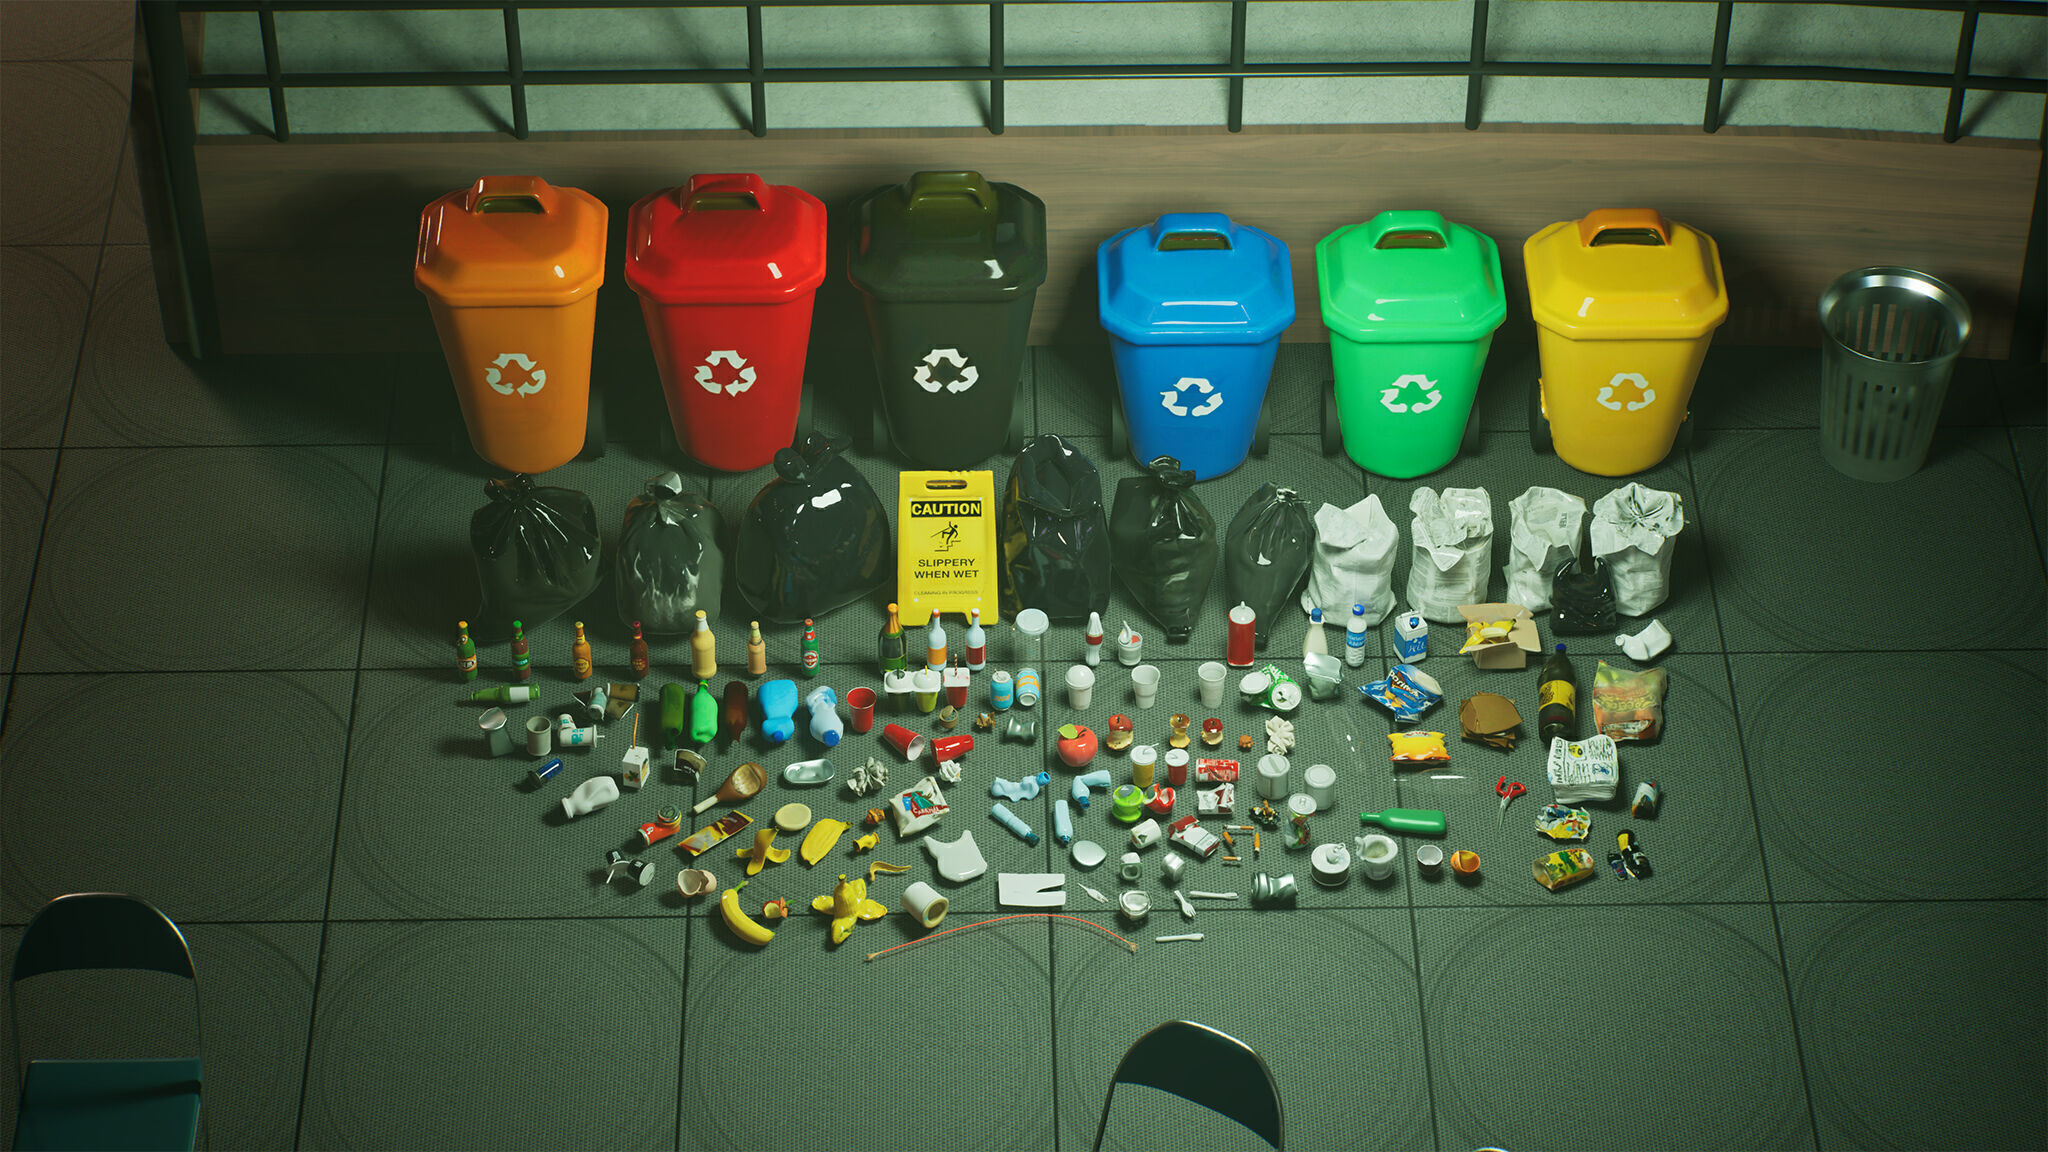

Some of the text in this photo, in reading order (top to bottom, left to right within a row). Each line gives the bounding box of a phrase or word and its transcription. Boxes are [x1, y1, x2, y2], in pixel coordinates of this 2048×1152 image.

[912, 503, 980, 515] CAUTION
[918, 558, 975, 567] SLIPPERY
[914, 570, 979, 579] WHEN WET
